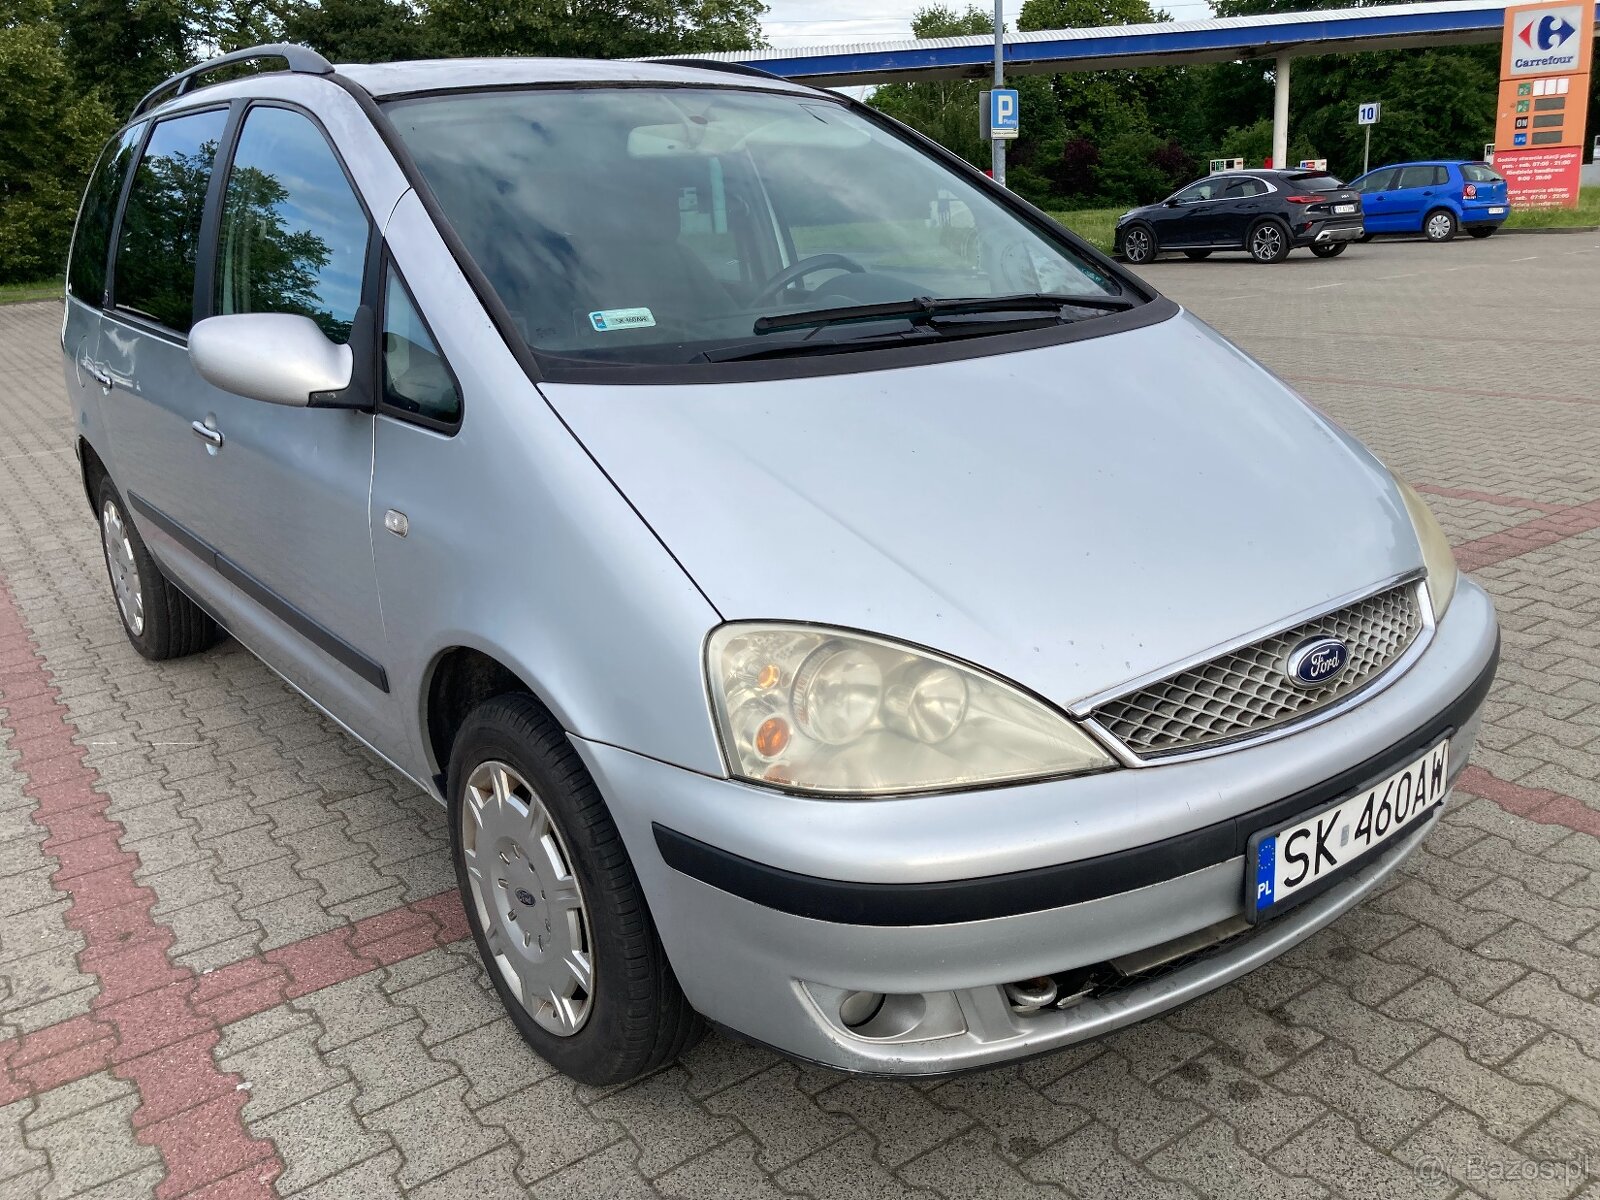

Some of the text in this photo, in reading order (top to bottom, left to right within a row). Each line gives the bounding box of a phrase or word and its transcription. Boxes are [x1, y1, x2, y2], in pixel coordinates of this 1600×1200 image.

[1515, 55, 1573, 68] Carrefour
[998, 95, 1013, 124] P
[1361, 107, 1374, 120] 10
[1516, 119, 1528, 127] ON
[1310, 648, 1340, 677] Ford
[1284, 743, 1446, 888] SK 460AW
[1257, 881, 1272, 900] PL
